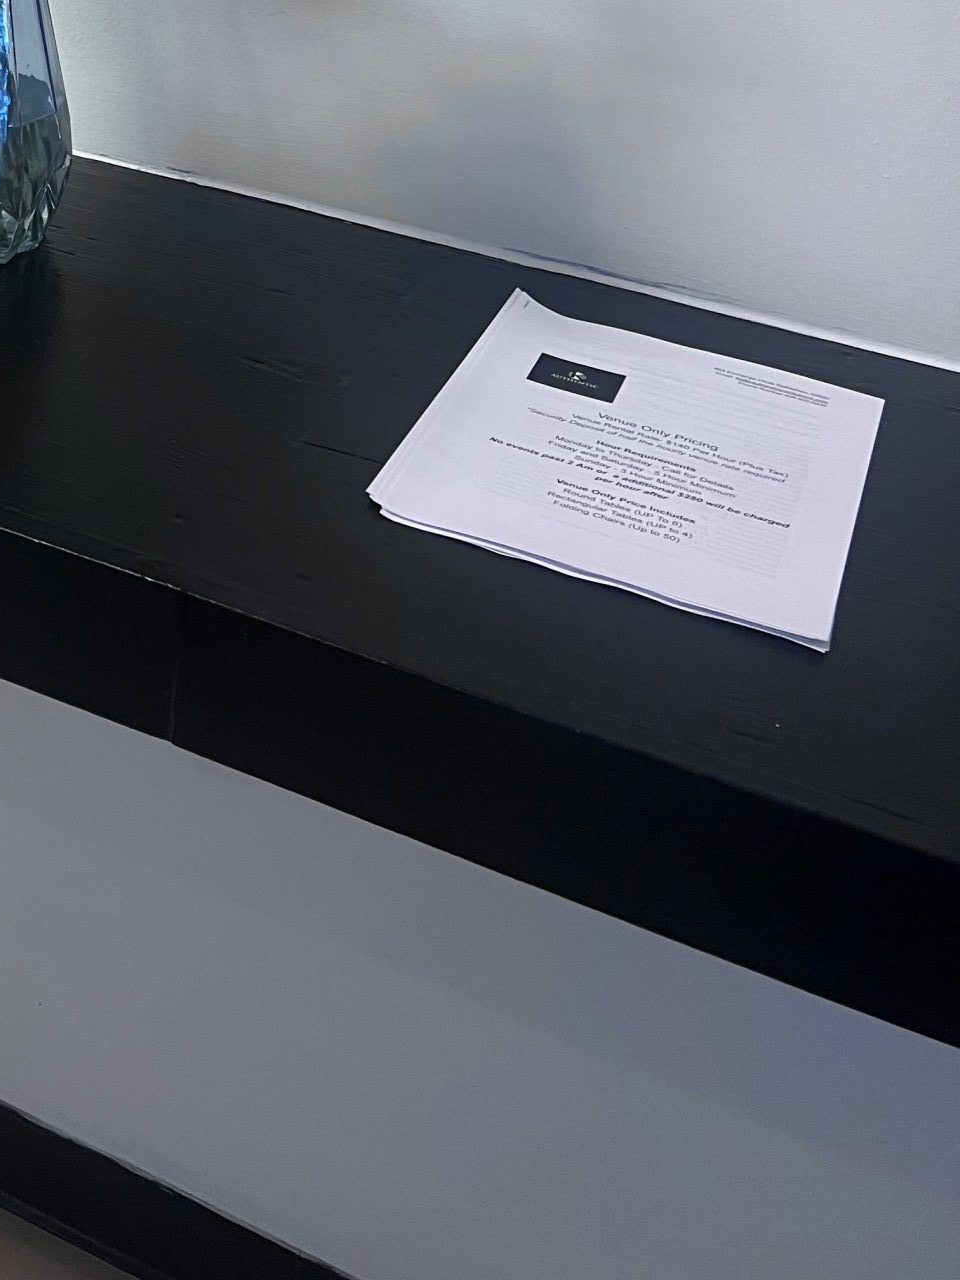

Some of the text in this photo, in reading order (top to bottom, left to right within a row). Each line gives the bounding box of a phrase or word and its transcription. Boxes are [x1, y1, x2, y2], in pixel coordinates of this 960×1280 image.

[568, 419, 605, 433] Deposit
[618, 432, 638, 442] half
[656, 443, 687, 456] hourly
[688, 453, 719, 466] venue
[743, 469, 786, 483] required
[572, 413, 602, 426] Venue
[603, 422, 635, 434] Rental
[692, 446, 710, 456] Per
[712, 452, 737, 463] Hour
[739, 460, 764, 471] (Plus
[598, 412, 719, 452] Venue Only Pricing
[548, 440, 578, 453] Friday
[580, 450, 598, 459] and
[600, 454, 645, 472] Saturday
[662, 473, 687, 484] Hour
[689, 481, 736, 498] Minimum
[555, 435, 593, 451] Monday
[608, 450, 652, 467] Thursday
[662, 465, 681, 475] Call
[683, 470, 697, 479] for
[699, 476, 734, 491] Details
[573, 454, 612, 470] Sunday
[629, 471, 654, 482] Hour
[656, 477, 702, 496] Minimum
[596, 439, 696, 472] Hour Requirements
[489, 436, 504, 445] No
[506, 442, 539, 456] events
[540, 453, 565, 464] past
[575, 462, 594, 471] Am
[596, 468, 608, 476] or
[622, 477, 676, 495] additional
[706, 500, 725, 510] will
[727, 506, 741, 515] be
[743, 512, 791, 529] charged
[556, 478, 696, 524] Venue Only Price Includes
[562, 488, 596, 502] Round
[599, 499, 631, 513] Tables
[594, 476, 669, 500] per hour after
[547, 490, 608, 513] Rectangular
[611, 510, 643, 524] Tables
[553, 500, 590, 516] Folding
[592, 512, 625, 527] Chairs
